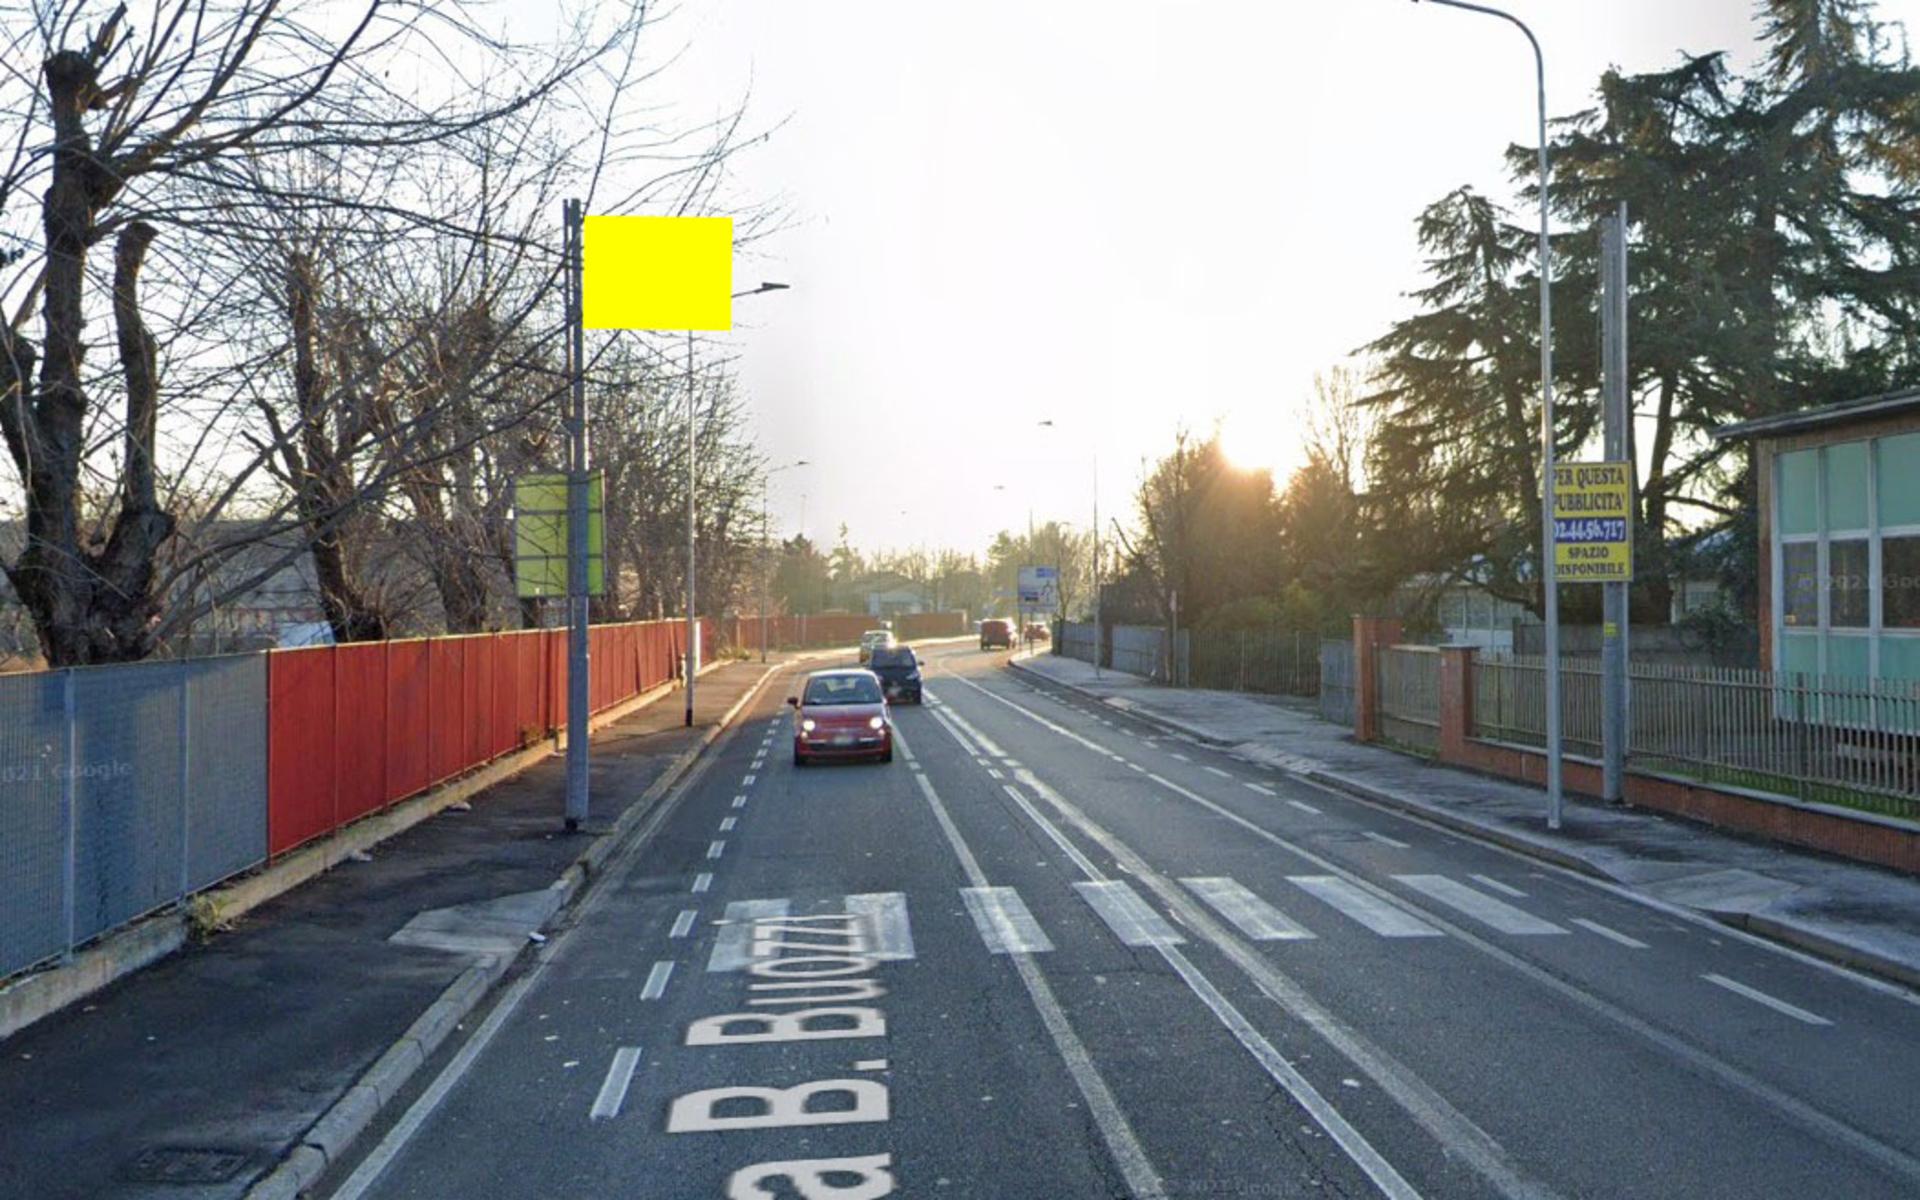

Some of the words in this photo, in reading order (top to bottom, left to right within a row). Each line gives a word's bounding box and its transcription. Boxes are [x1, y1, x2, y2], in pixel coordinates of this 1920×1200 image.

[1577, 468, 1625, 489] QUESTA
[1567, 546, 1609, 559] SPAZIO
[686, 912, 888, 1046] Buozzi
[667, 1059, 890, 1133] B.
